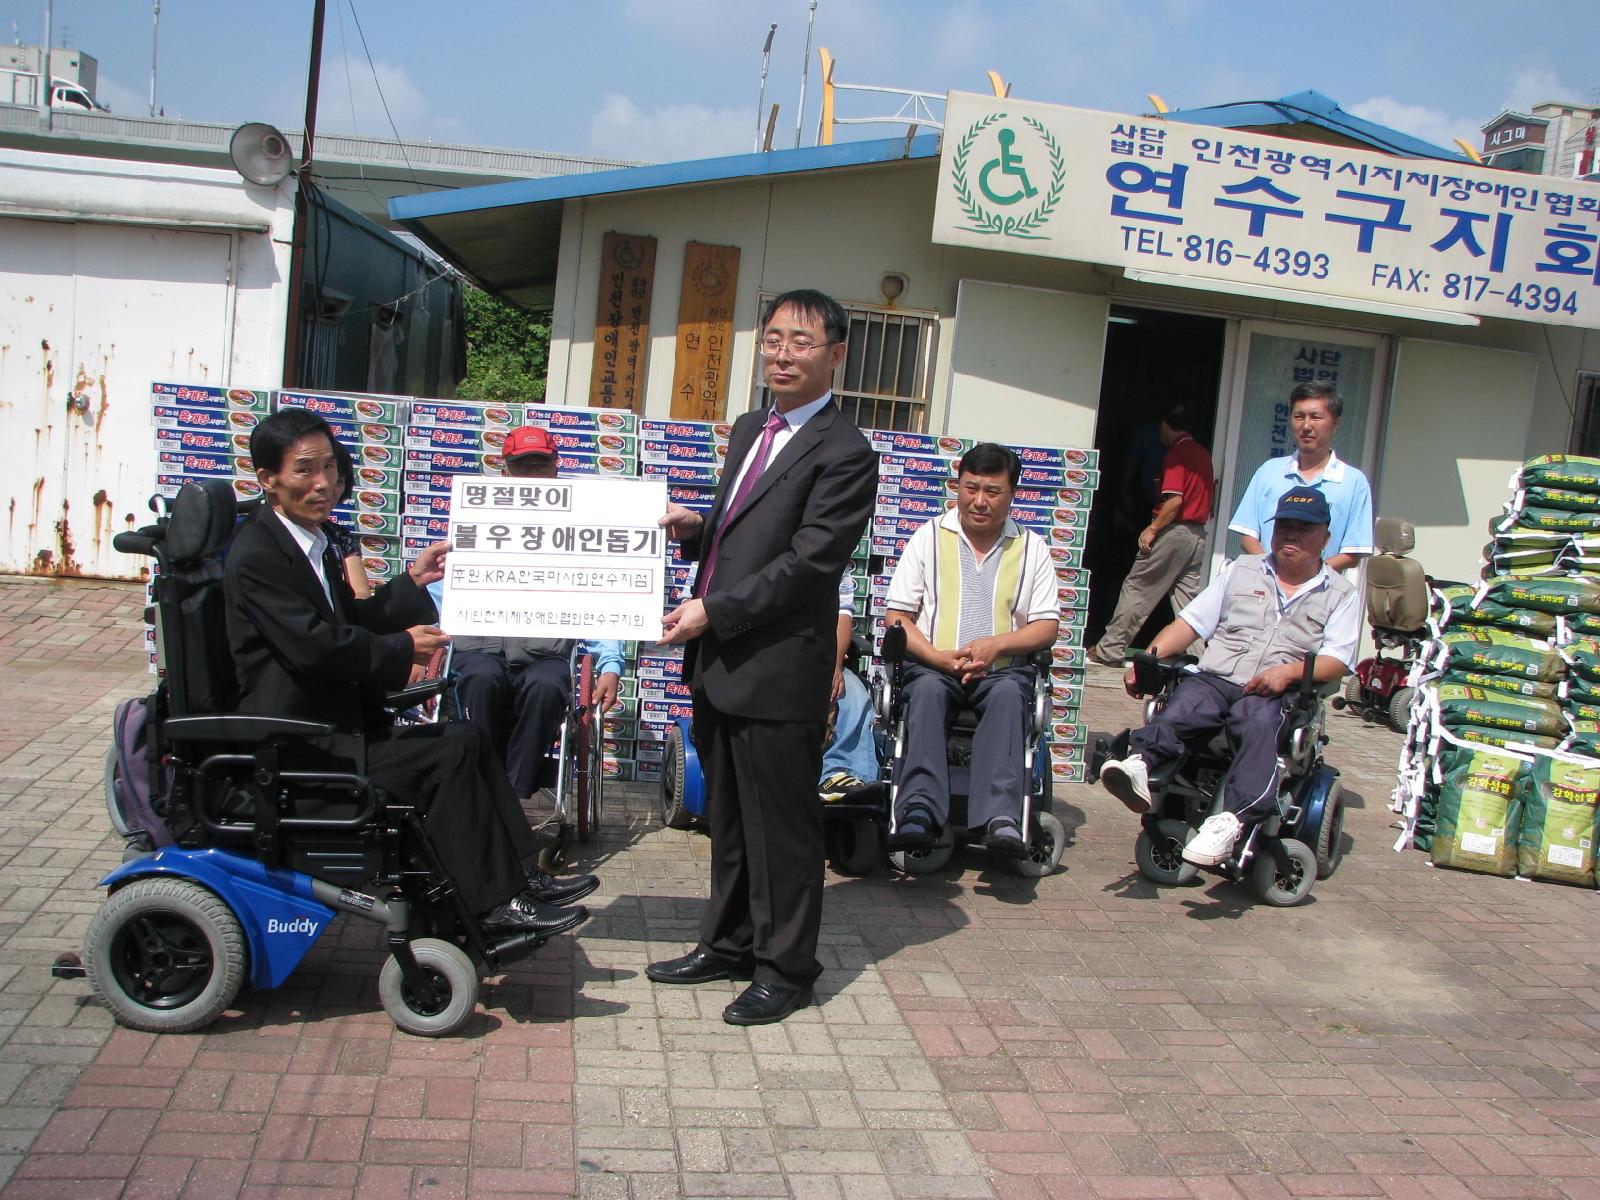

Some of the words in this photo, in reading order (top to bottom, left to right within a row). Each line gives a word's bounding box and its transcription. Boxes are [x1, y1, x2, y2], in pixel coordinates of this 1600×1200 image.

[1111, 123, 1167, 143] 사단
[1111, 139, 1163, 160] 법인
[1372, 263, 1430, 293] FAX:
[1443, 273, 1578, 315] 817-4394
[1294, 346, 1342, 367] 사단
[431, 475, 453, 488] 육개
[466, 485, 568, 508] 명절맞이
[267, 918, 319, 937] Buddy
